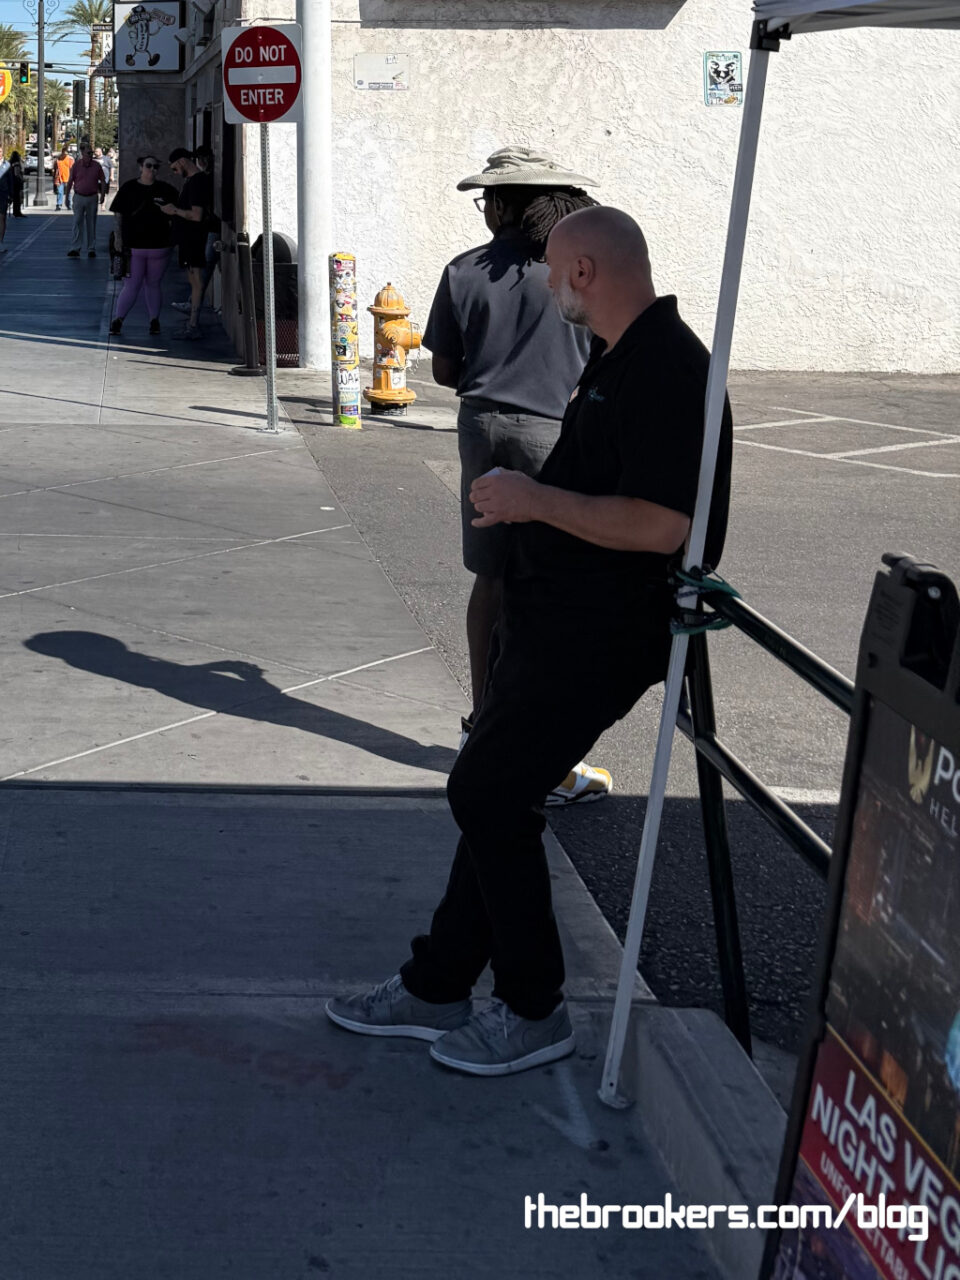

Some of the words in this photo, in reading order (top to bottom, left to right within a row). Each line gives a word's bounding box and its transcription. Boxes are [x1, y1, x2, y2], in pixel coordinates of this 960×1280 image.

[234, 44, 255, 64] DO
[258, 42, 287, 63] NOT
[240, 89, 284, 107] ENTER
[844, 1069, 897, 1163] LAS
